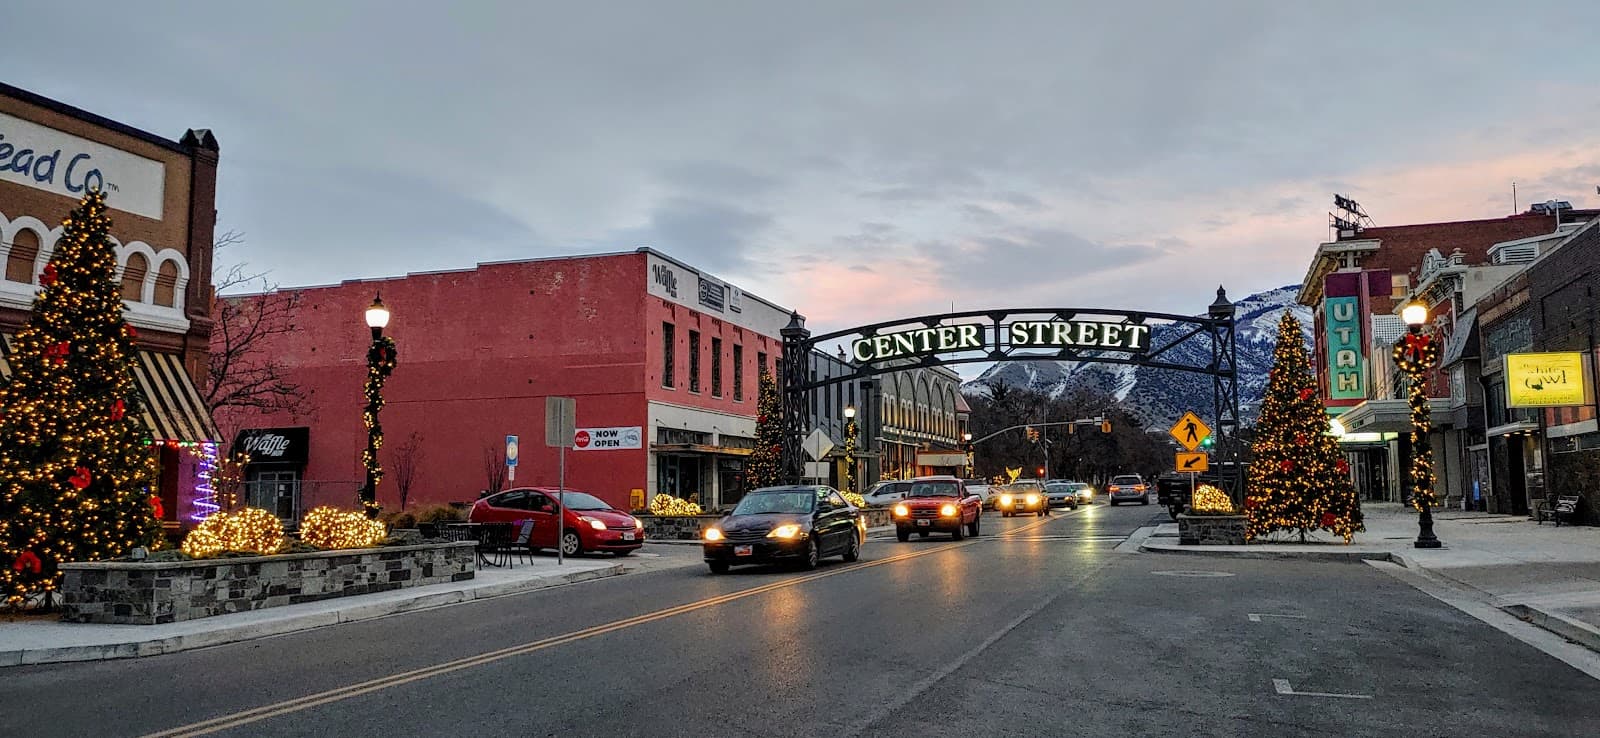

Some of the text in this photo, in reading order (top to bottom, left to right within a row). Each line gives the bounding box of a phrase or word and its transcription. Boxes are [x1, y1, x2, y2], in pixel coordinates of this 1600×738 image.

[0, 134, 61, 185] ead
[652, 264, 678, 293] Waffle
[853, 321, 1148, 361] CENTER STREET
[1333, 303, 1359, 392] UTAH
[243, 435, 291, 456] Waffle
[594, 439, 620, 447] OPEN
[596, 430, 618, 438] NOW
